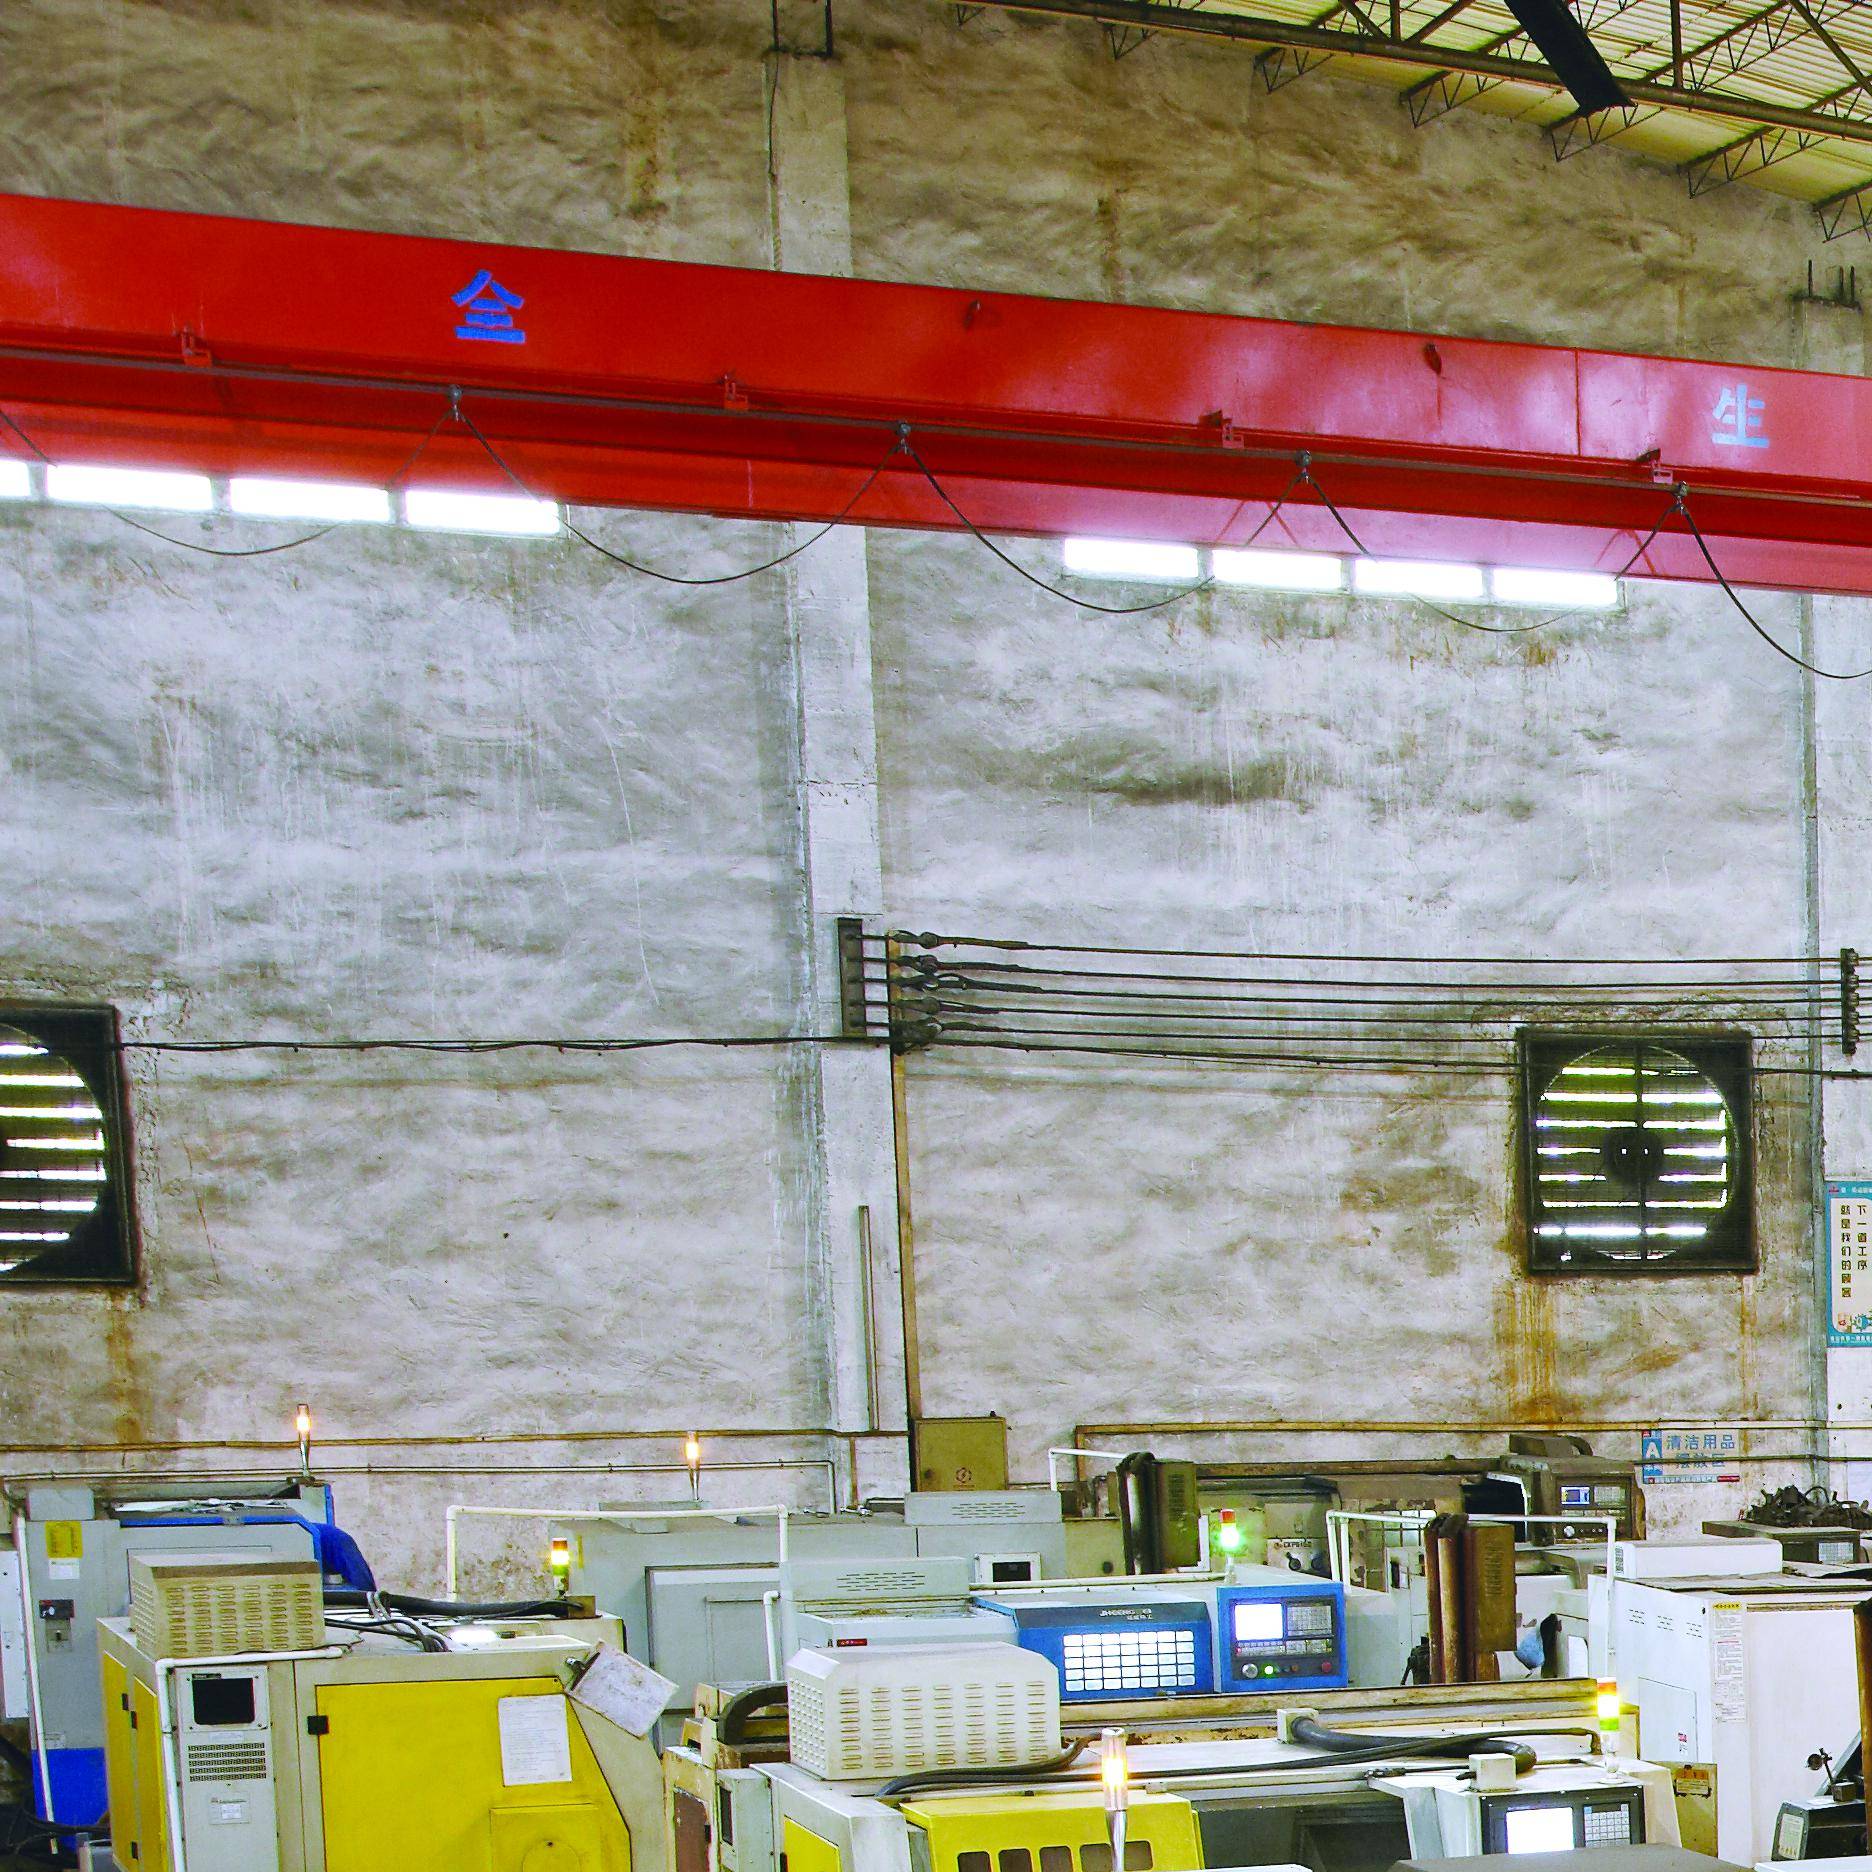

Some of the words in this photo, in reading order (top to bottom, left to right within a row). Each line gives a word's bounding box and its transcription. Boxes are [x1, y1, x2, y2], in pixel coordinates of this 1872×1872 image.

[1711, 383, 1771, 449] 生
[1667, 1434, 1735, 1450] 清洁用品
